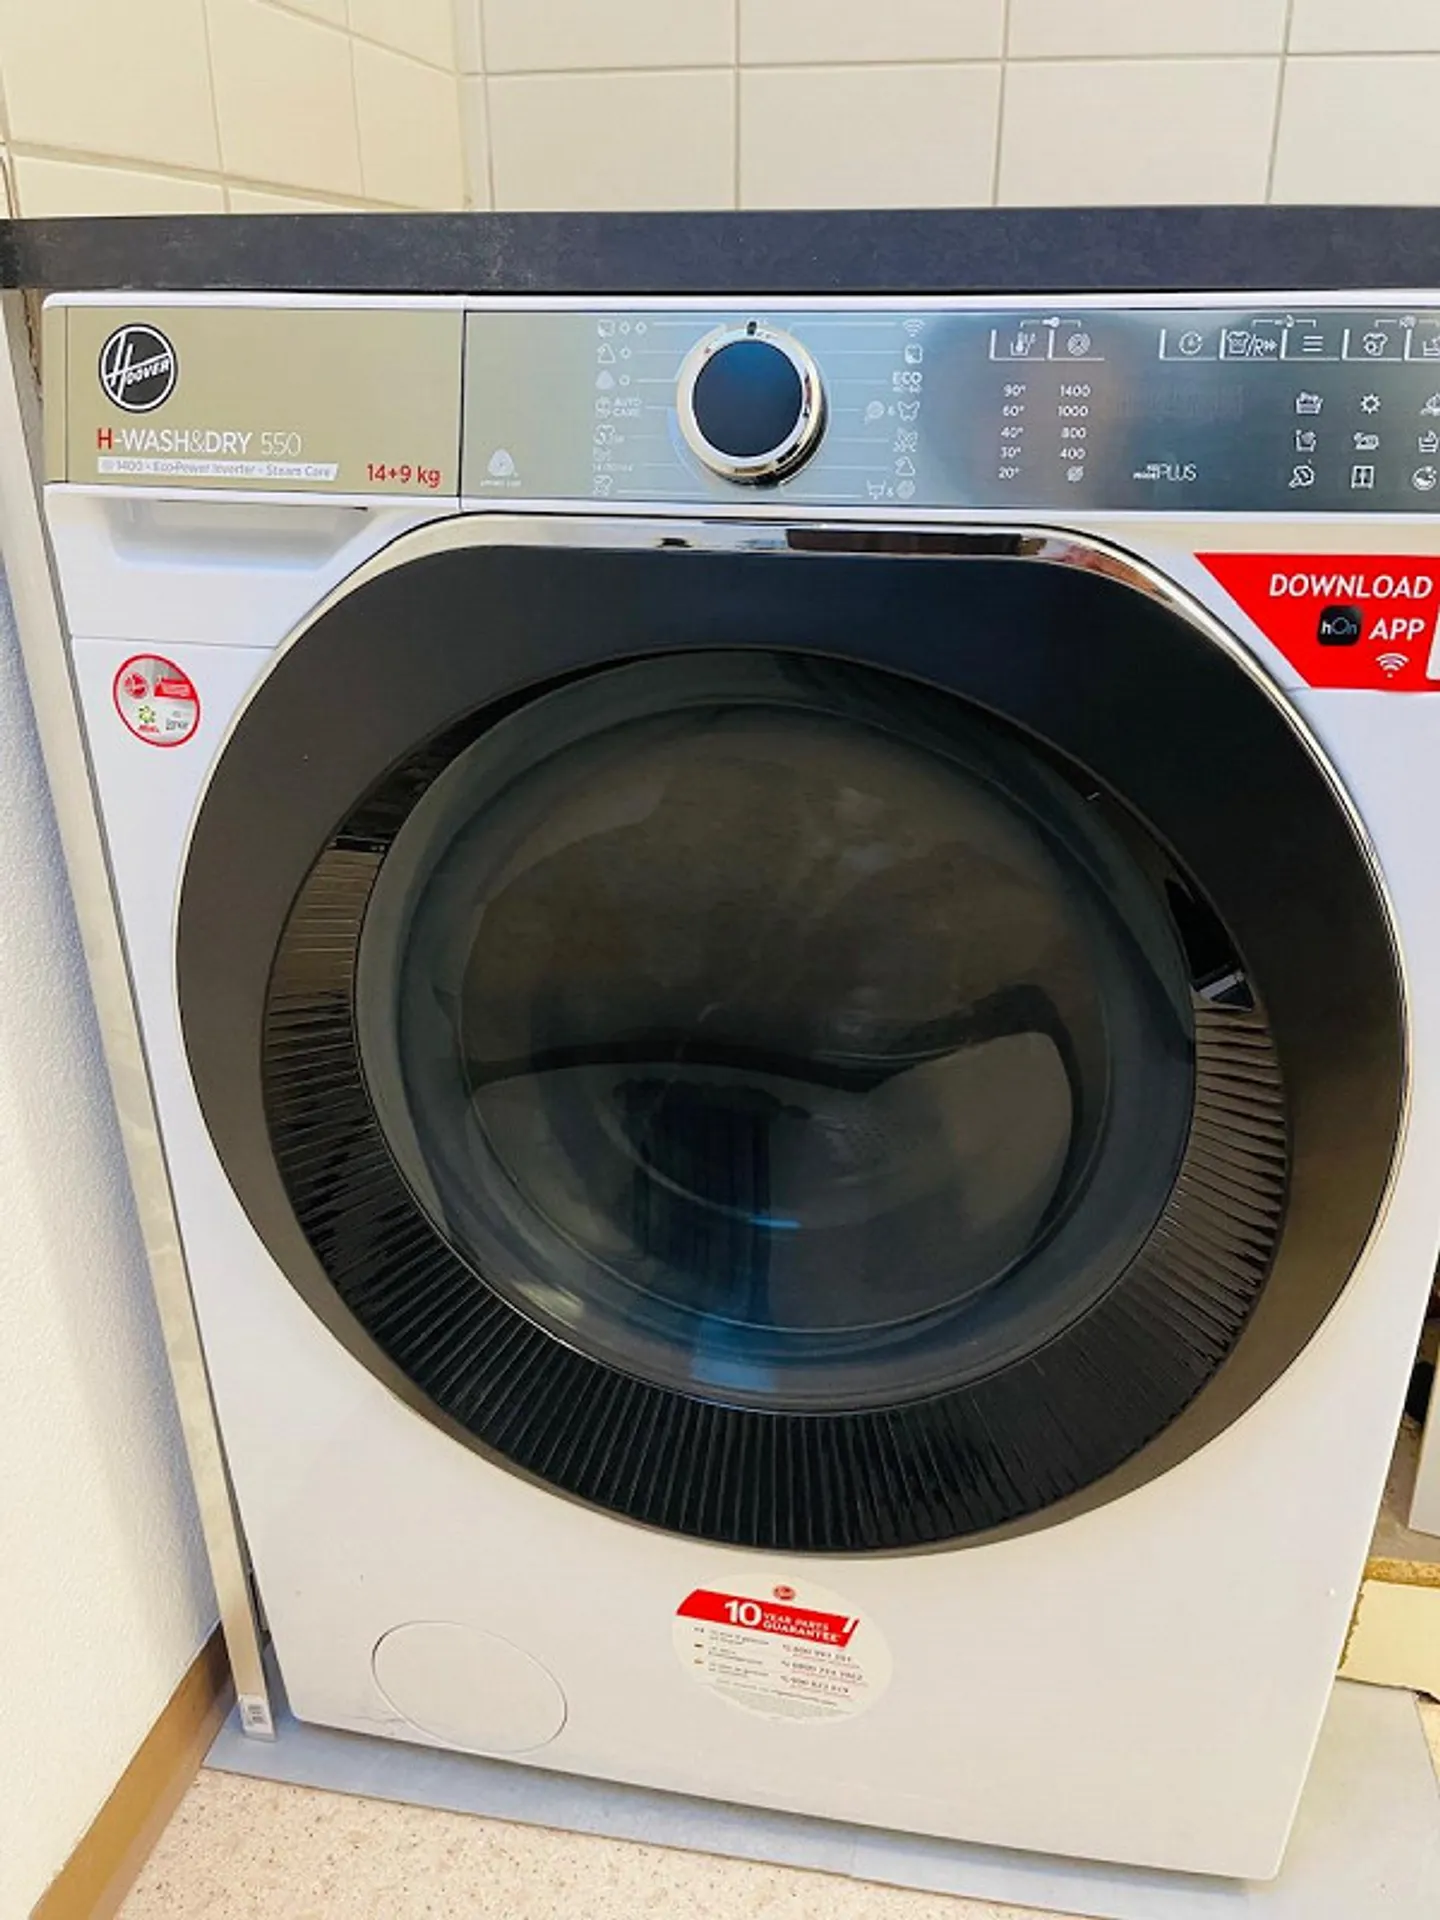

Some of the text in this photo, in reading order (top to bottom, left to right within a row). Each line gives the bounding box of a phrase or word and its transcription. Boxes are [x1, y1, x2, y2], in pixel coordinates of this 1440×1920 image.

[103, 330, 172, 402] HOOVER
[1060, 384, 1091, 397] 1400
[1058, 405, 1088, 417] 1000
[97, 427, 302, 457] H-WASH&DRY 550
[1061, 427, 1086, 439] 800
[1060, 447, 1086, 460] 400
[116, 460, 143, 471] 1400
[211, 463, 256, 475] Inverter
[266, 463, 302, 477] Steam
[367, 463, 440, 488] 14+9 kg
[1157, 463, 1197, 481] PLUS
[1269, 573, 1433, 599] DOWNLOAD
[1369, 618, 1425, 641] APP
[724, 1600, 762, 1627] 10
[763, 1612, 792, 1624] YEAR
